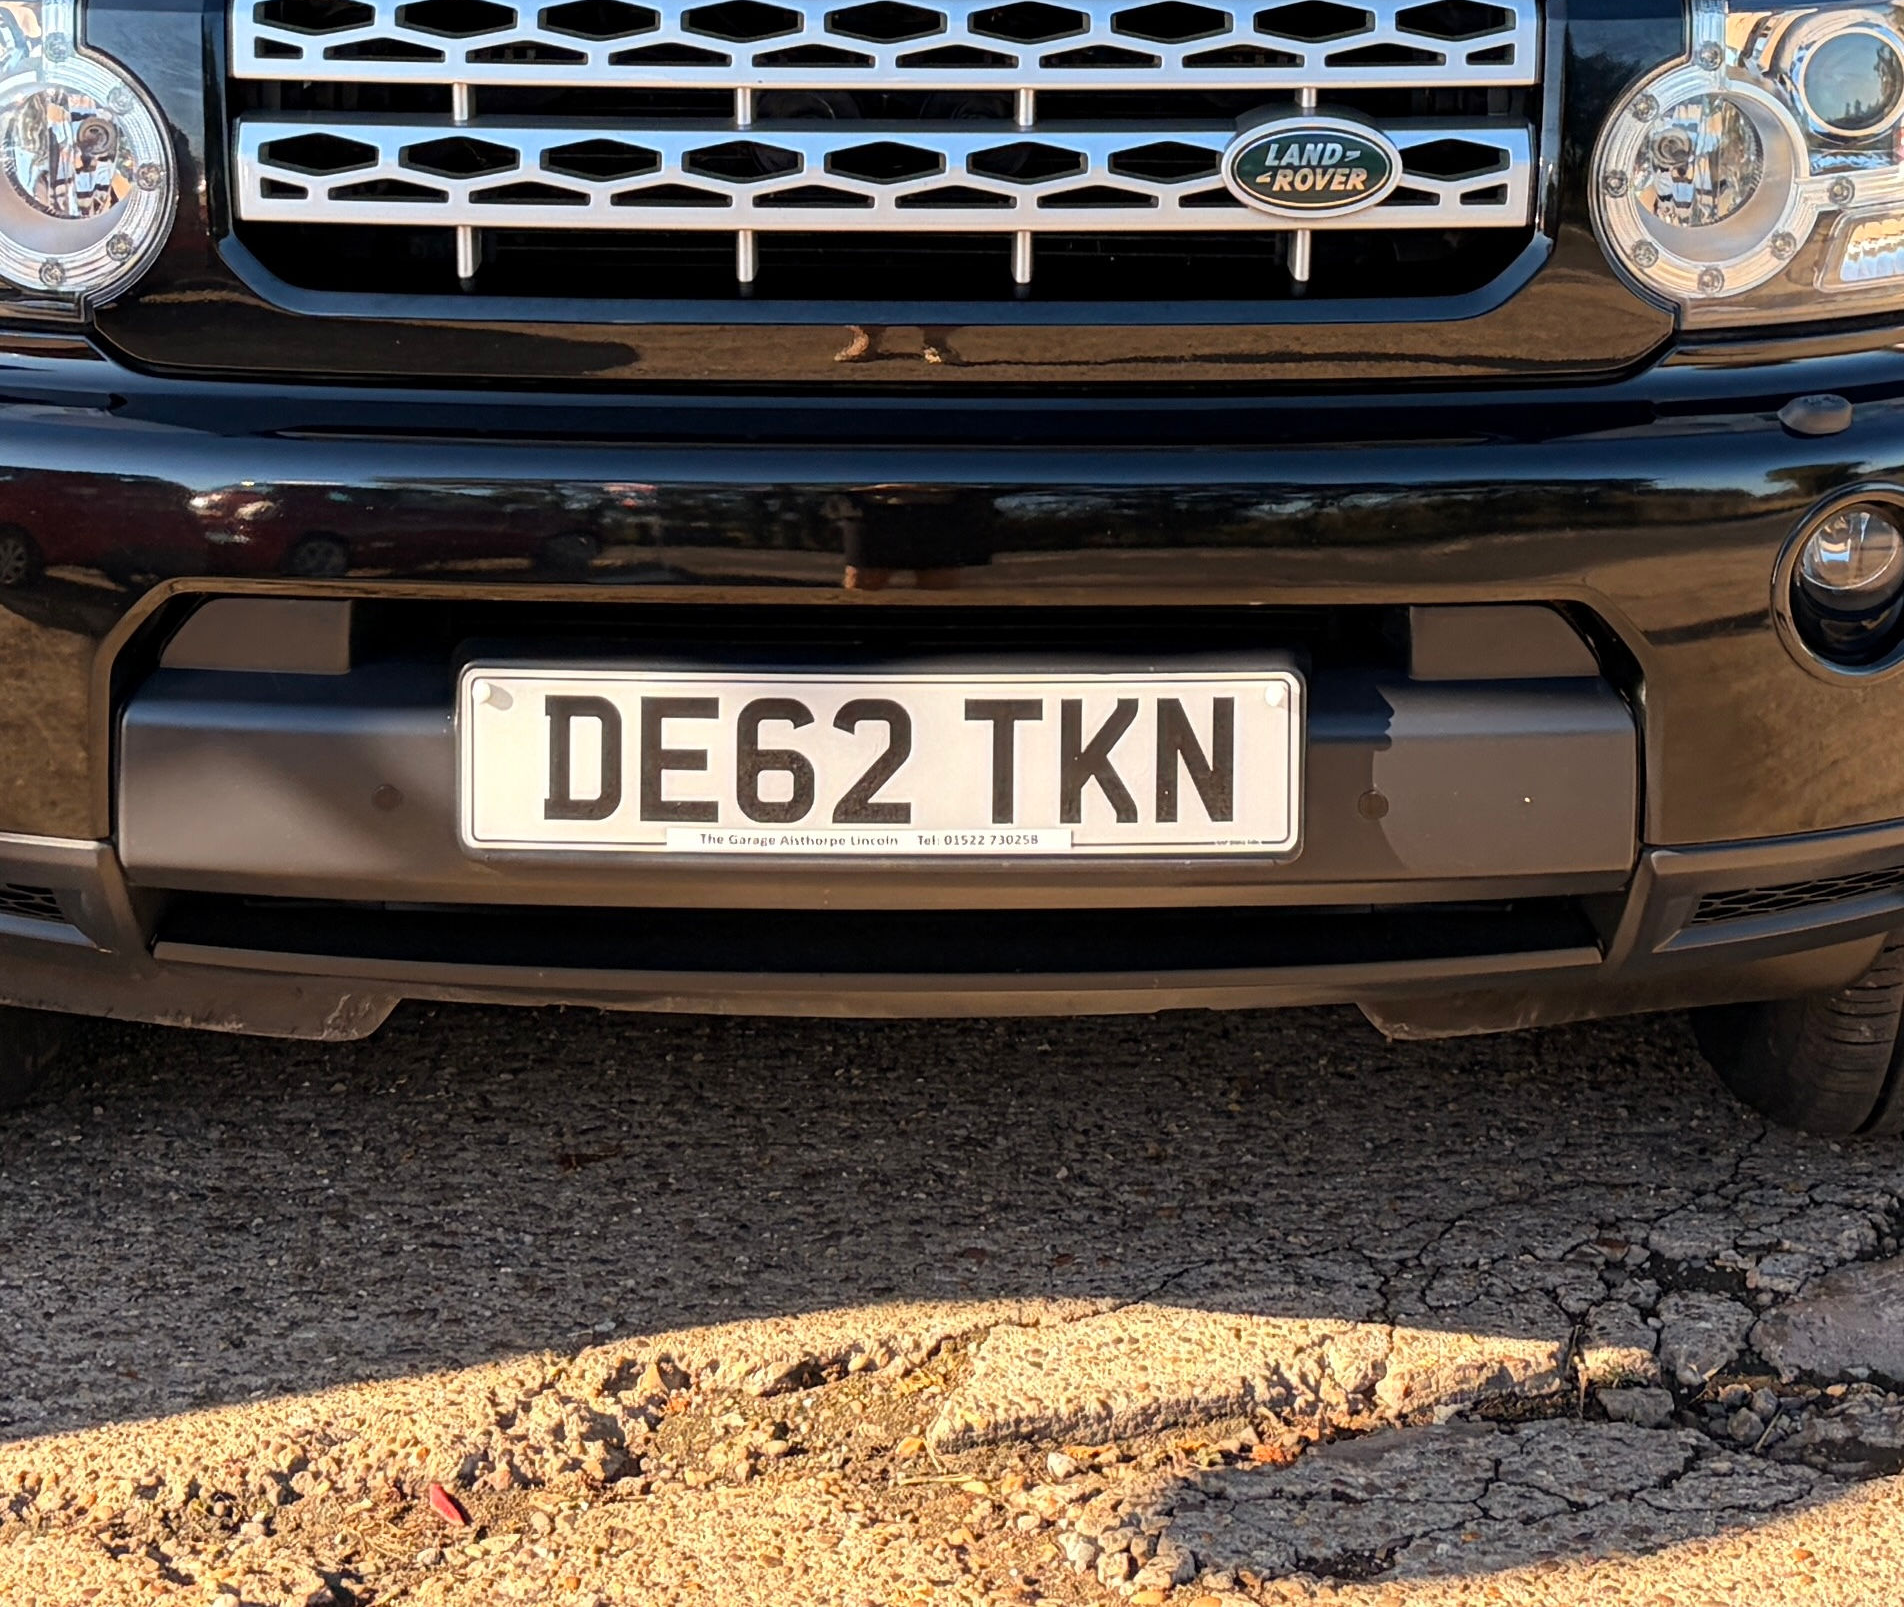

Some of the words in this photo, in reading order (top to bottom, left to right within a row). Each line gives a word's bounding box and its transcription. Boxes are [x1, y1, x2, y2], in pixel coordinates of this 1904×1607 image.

[1264, 142, 1343, 167] LAND
[1271, 167, 1369, 192] ROVER
[543, 694, 912, 824] DE62
[963, 696, 1236, 825] TKN
[700, 834, 724, 844] The
[728, 835, 776, 847] Garage
[850, 836, 899, 846] Lincoln
[917, 835, 941, 846] Tel:
[943, 835, 986, 846] 01522
